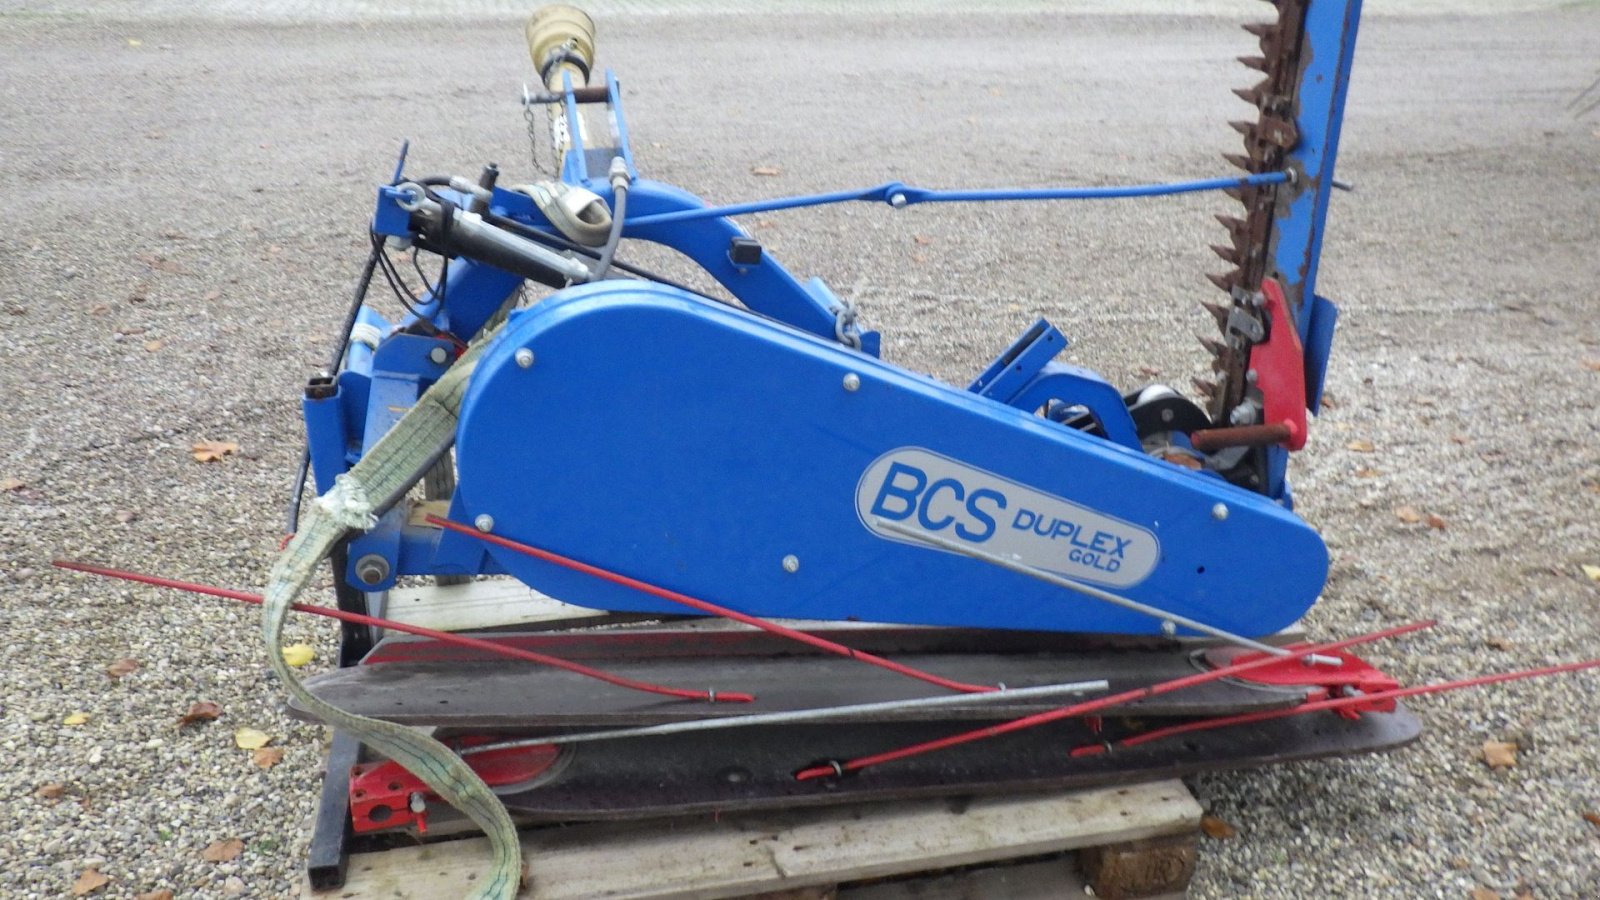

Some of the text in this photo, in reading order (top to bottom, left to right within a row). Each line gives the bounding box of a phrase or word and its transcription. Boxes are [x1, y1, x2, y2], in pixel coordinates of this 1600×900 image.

[870, 461, 1132, 558] BCS DUPLEX
[1068, 549, 1121, 573] GOLD
